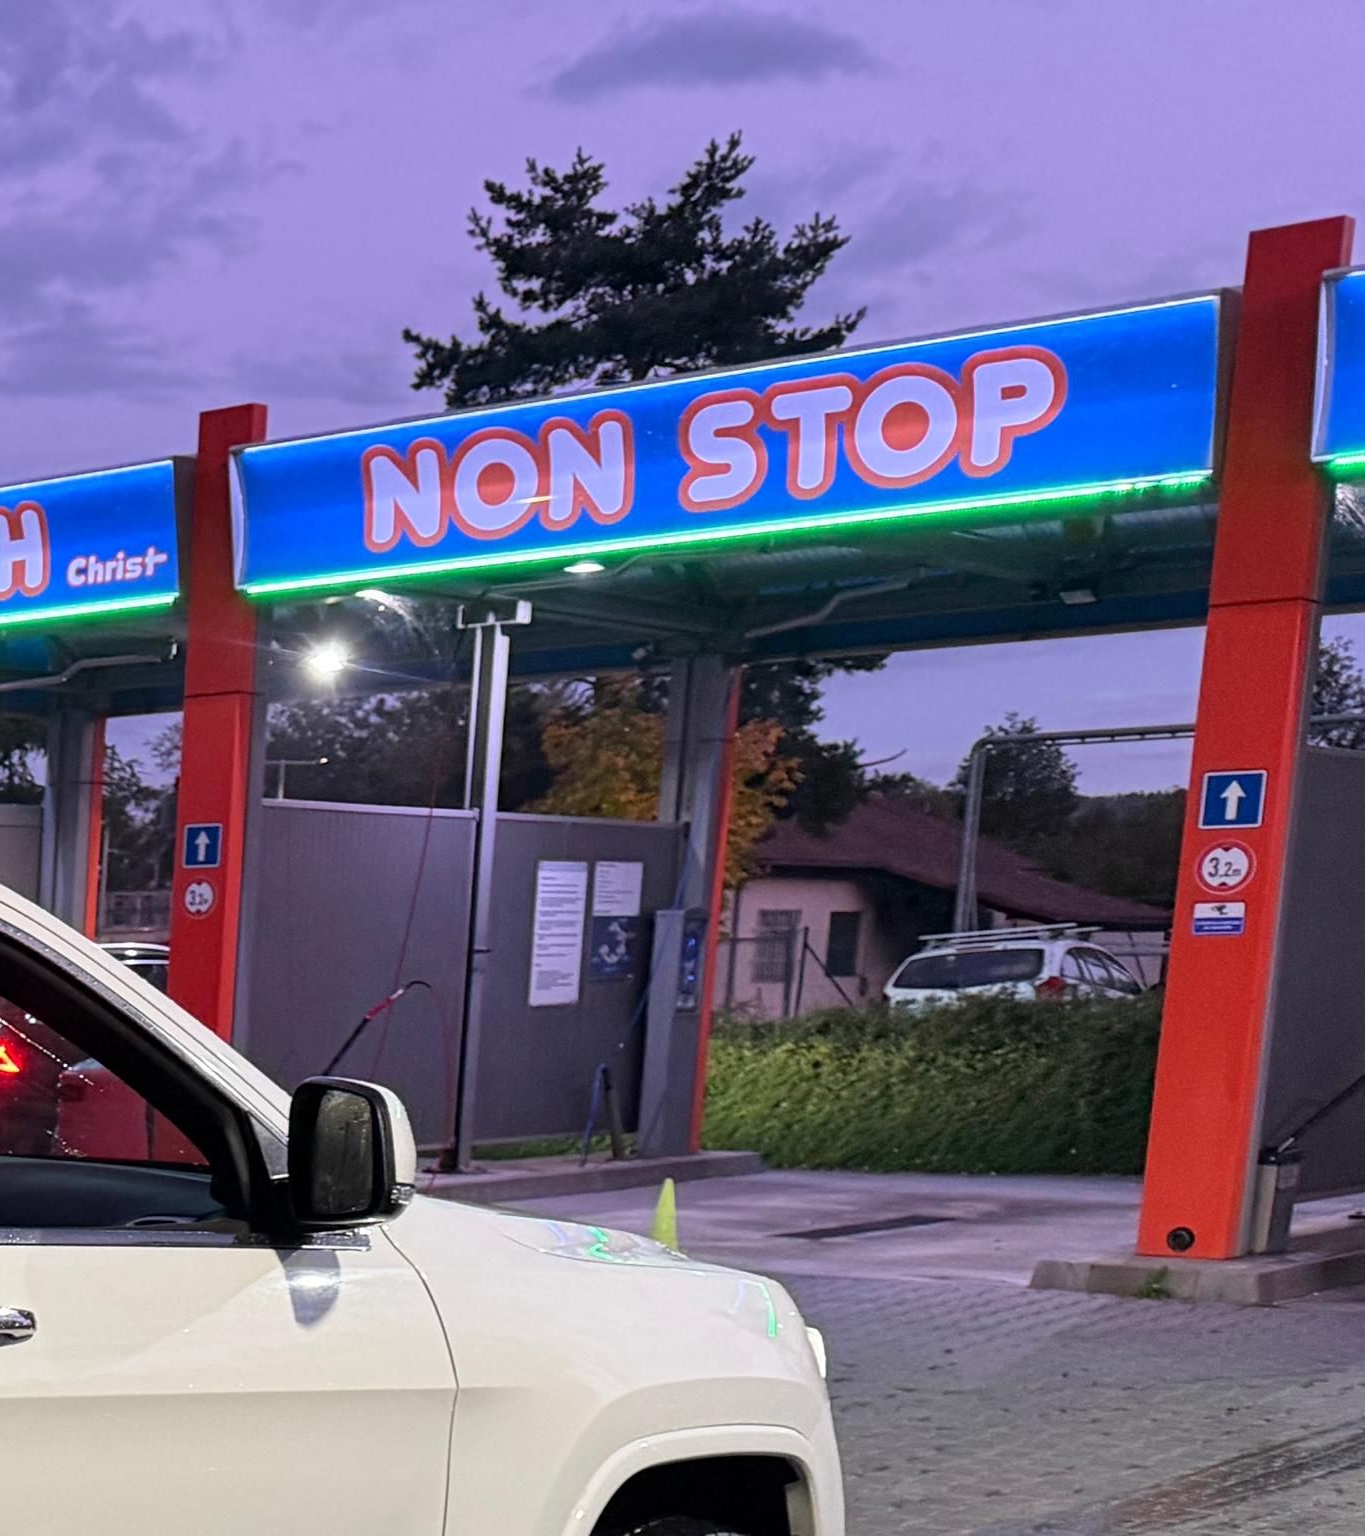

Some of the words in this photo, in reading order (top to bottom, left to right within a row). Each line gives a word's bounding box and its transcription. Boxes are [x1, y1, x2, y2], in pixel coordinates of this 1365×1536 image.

[363, 410, 633, 552] NON
[680, 346, 1067, 511] STOP
[67, 547, 166, 588] Christ
